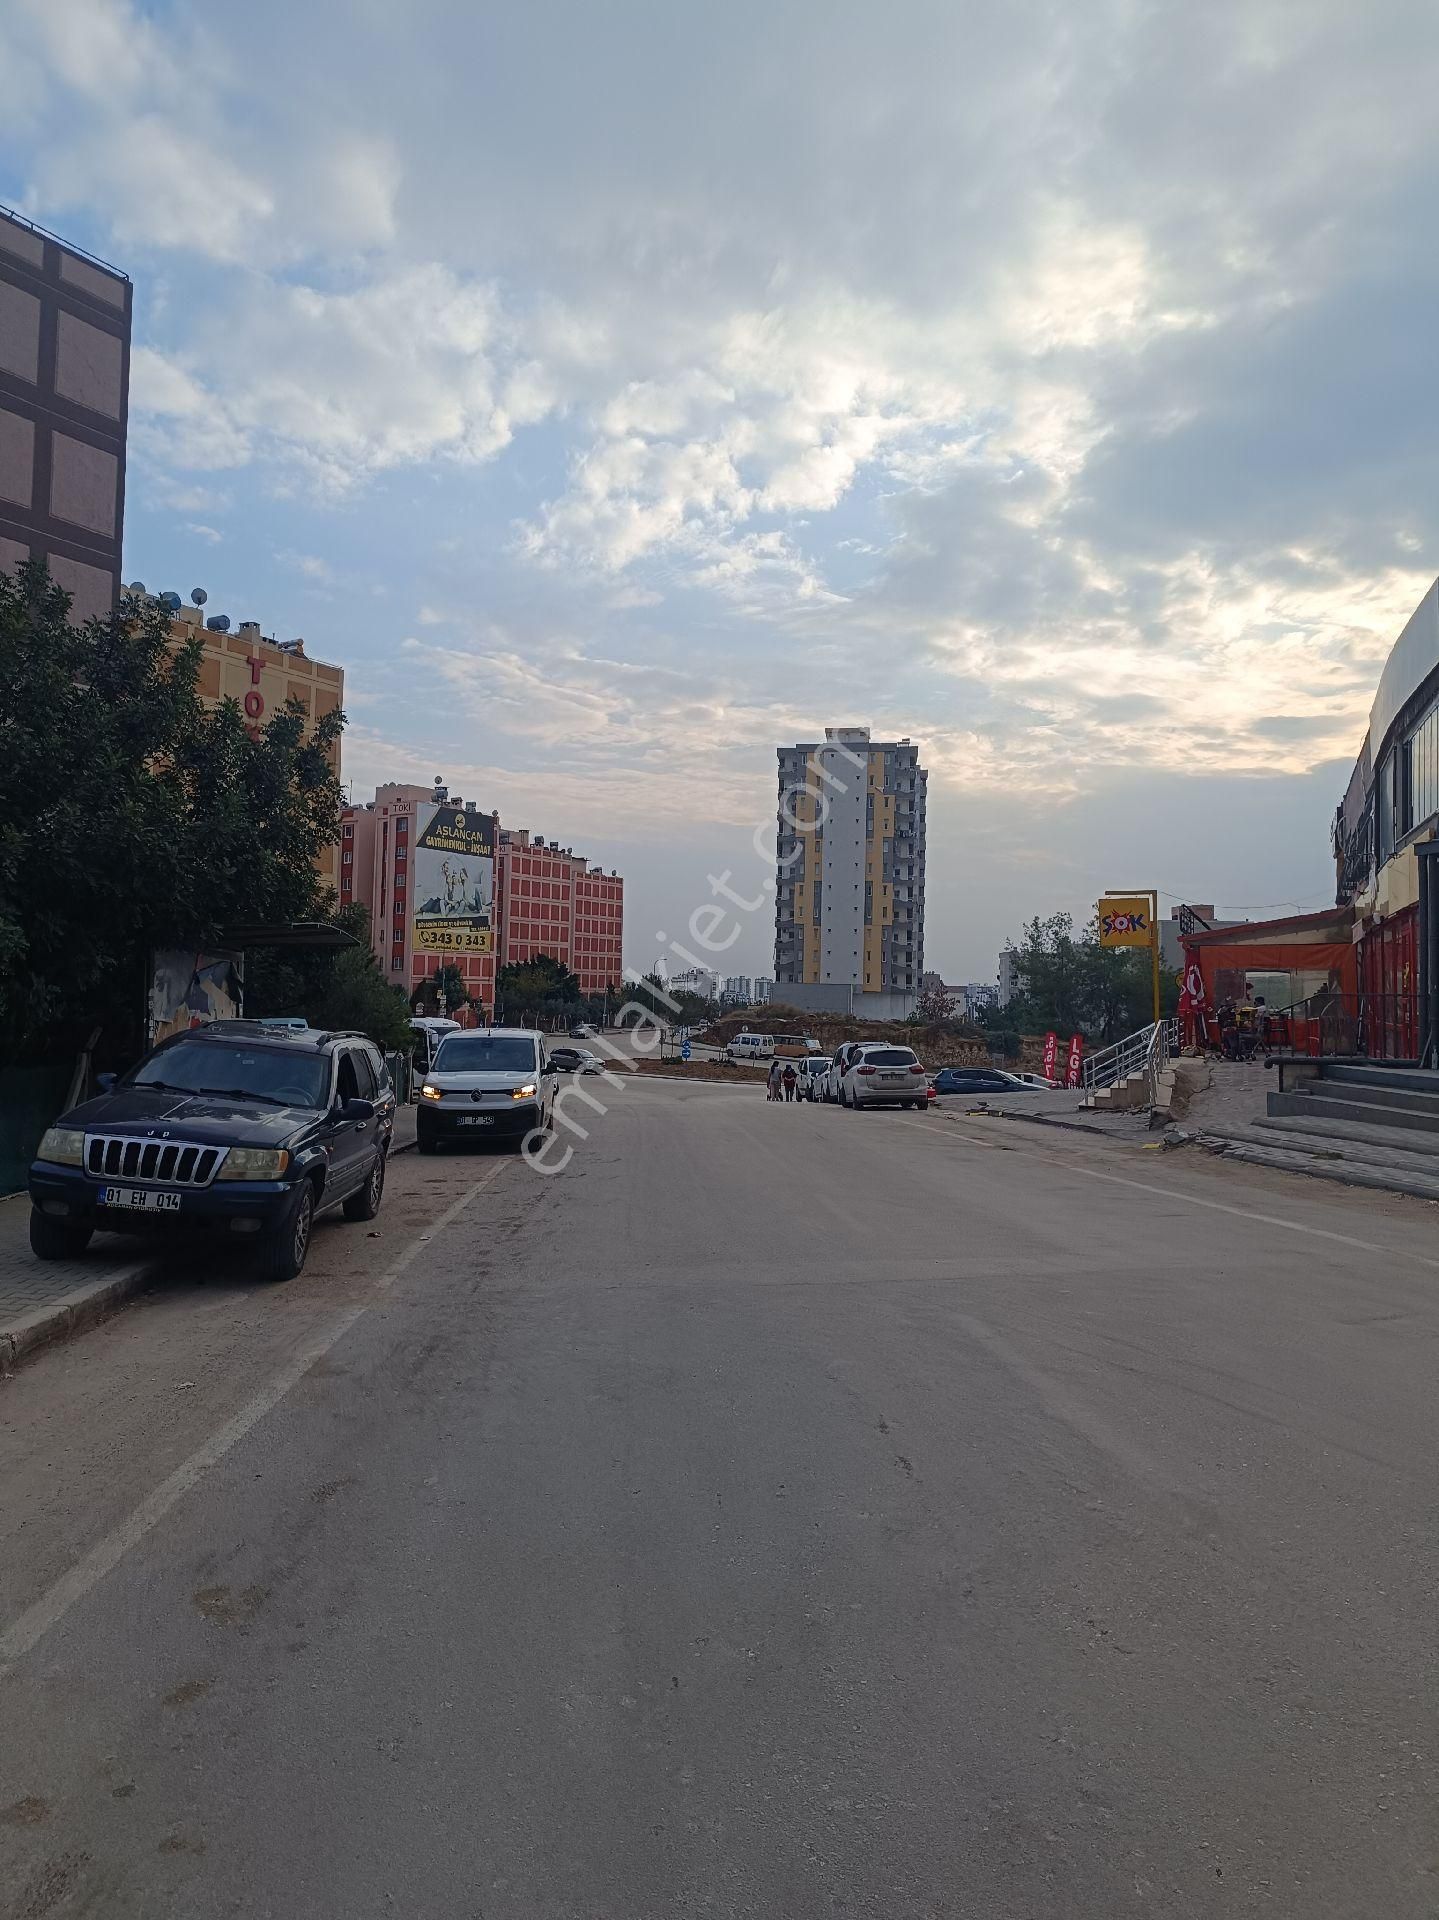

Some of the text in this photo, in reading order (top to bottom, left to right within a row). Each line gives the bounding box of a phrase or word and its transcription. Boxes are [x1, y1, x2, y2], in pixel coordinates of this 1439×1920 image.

[436, 825, 483, 842] ASLANCAN
[1102, 912, 1148, 938] ŞOK
[430, 932, 486, 945] 343 0 343
[107, 1188, 122, 1202] 01
[131, 1191, 147, 1206] EH
[156, 1193, 179, 1209] 014
